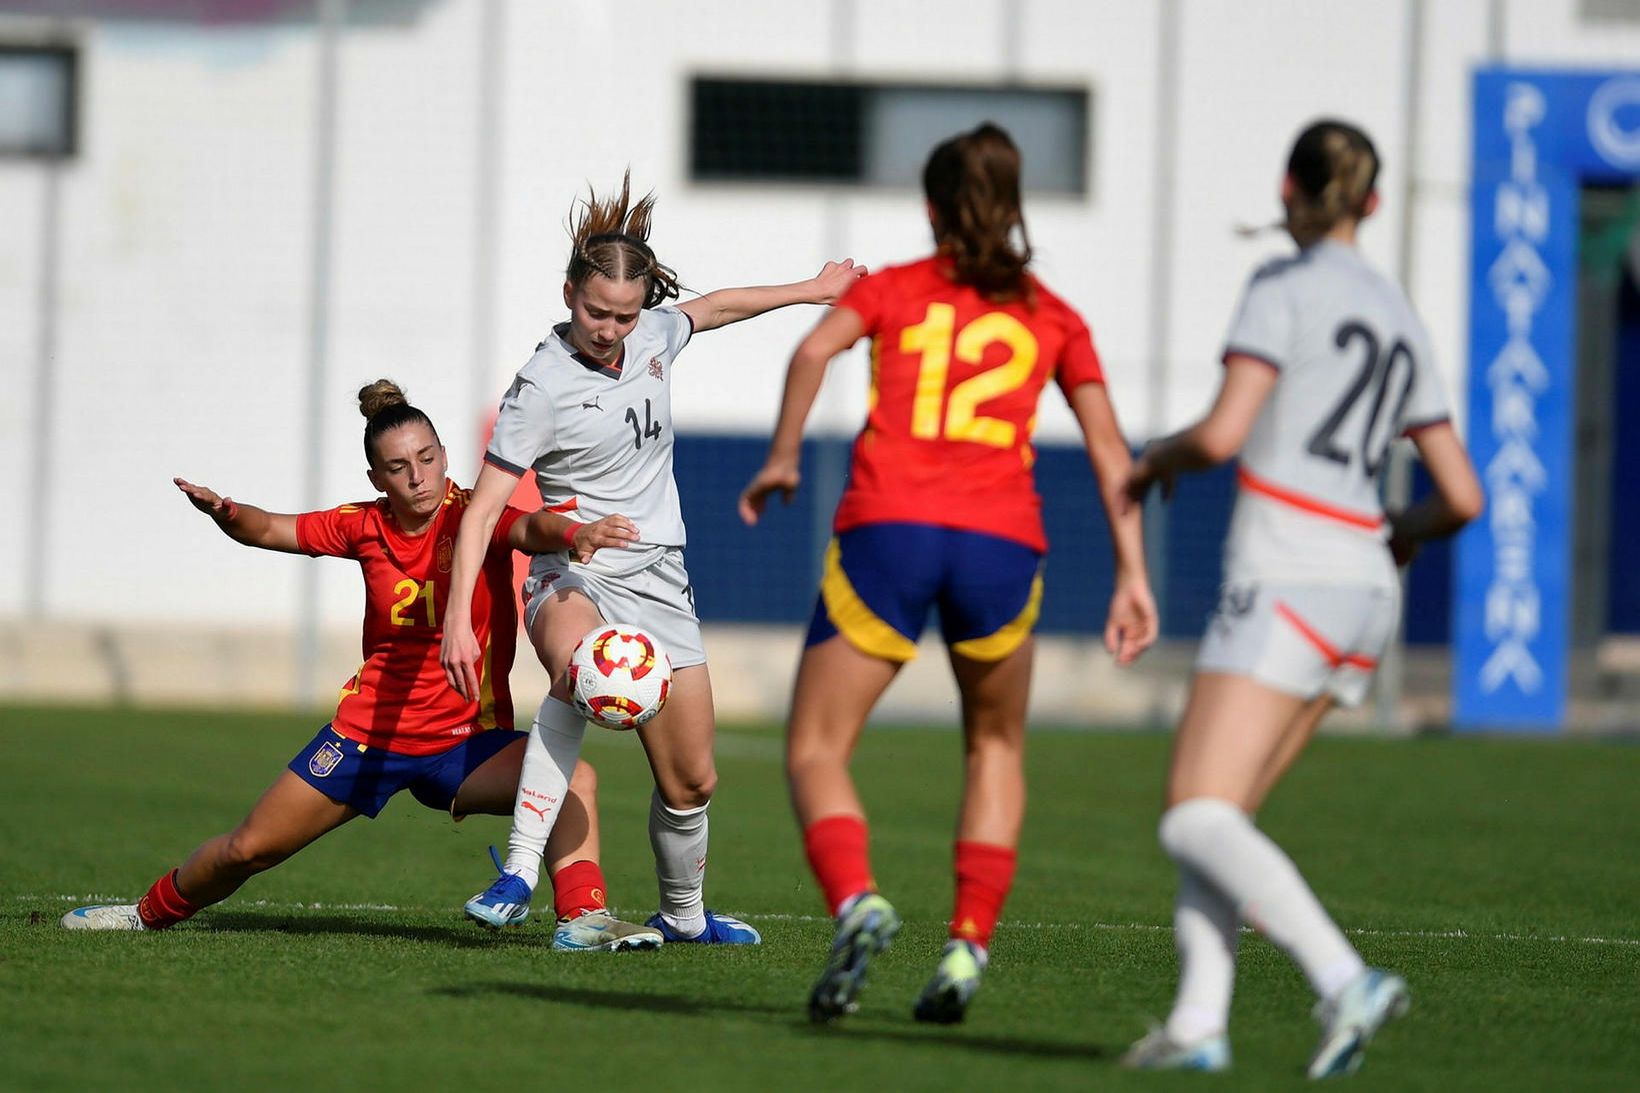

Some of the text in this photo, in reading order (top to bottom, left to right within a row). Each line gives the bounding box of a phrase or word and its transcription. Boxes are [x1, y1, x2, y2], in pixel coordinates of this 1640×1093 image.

[625, 398, 662, 449] 14
[900, 302, 1039, 449] 12
[1308, 316, 1416, 478] 20
[391, 579, 437, 628] 21
